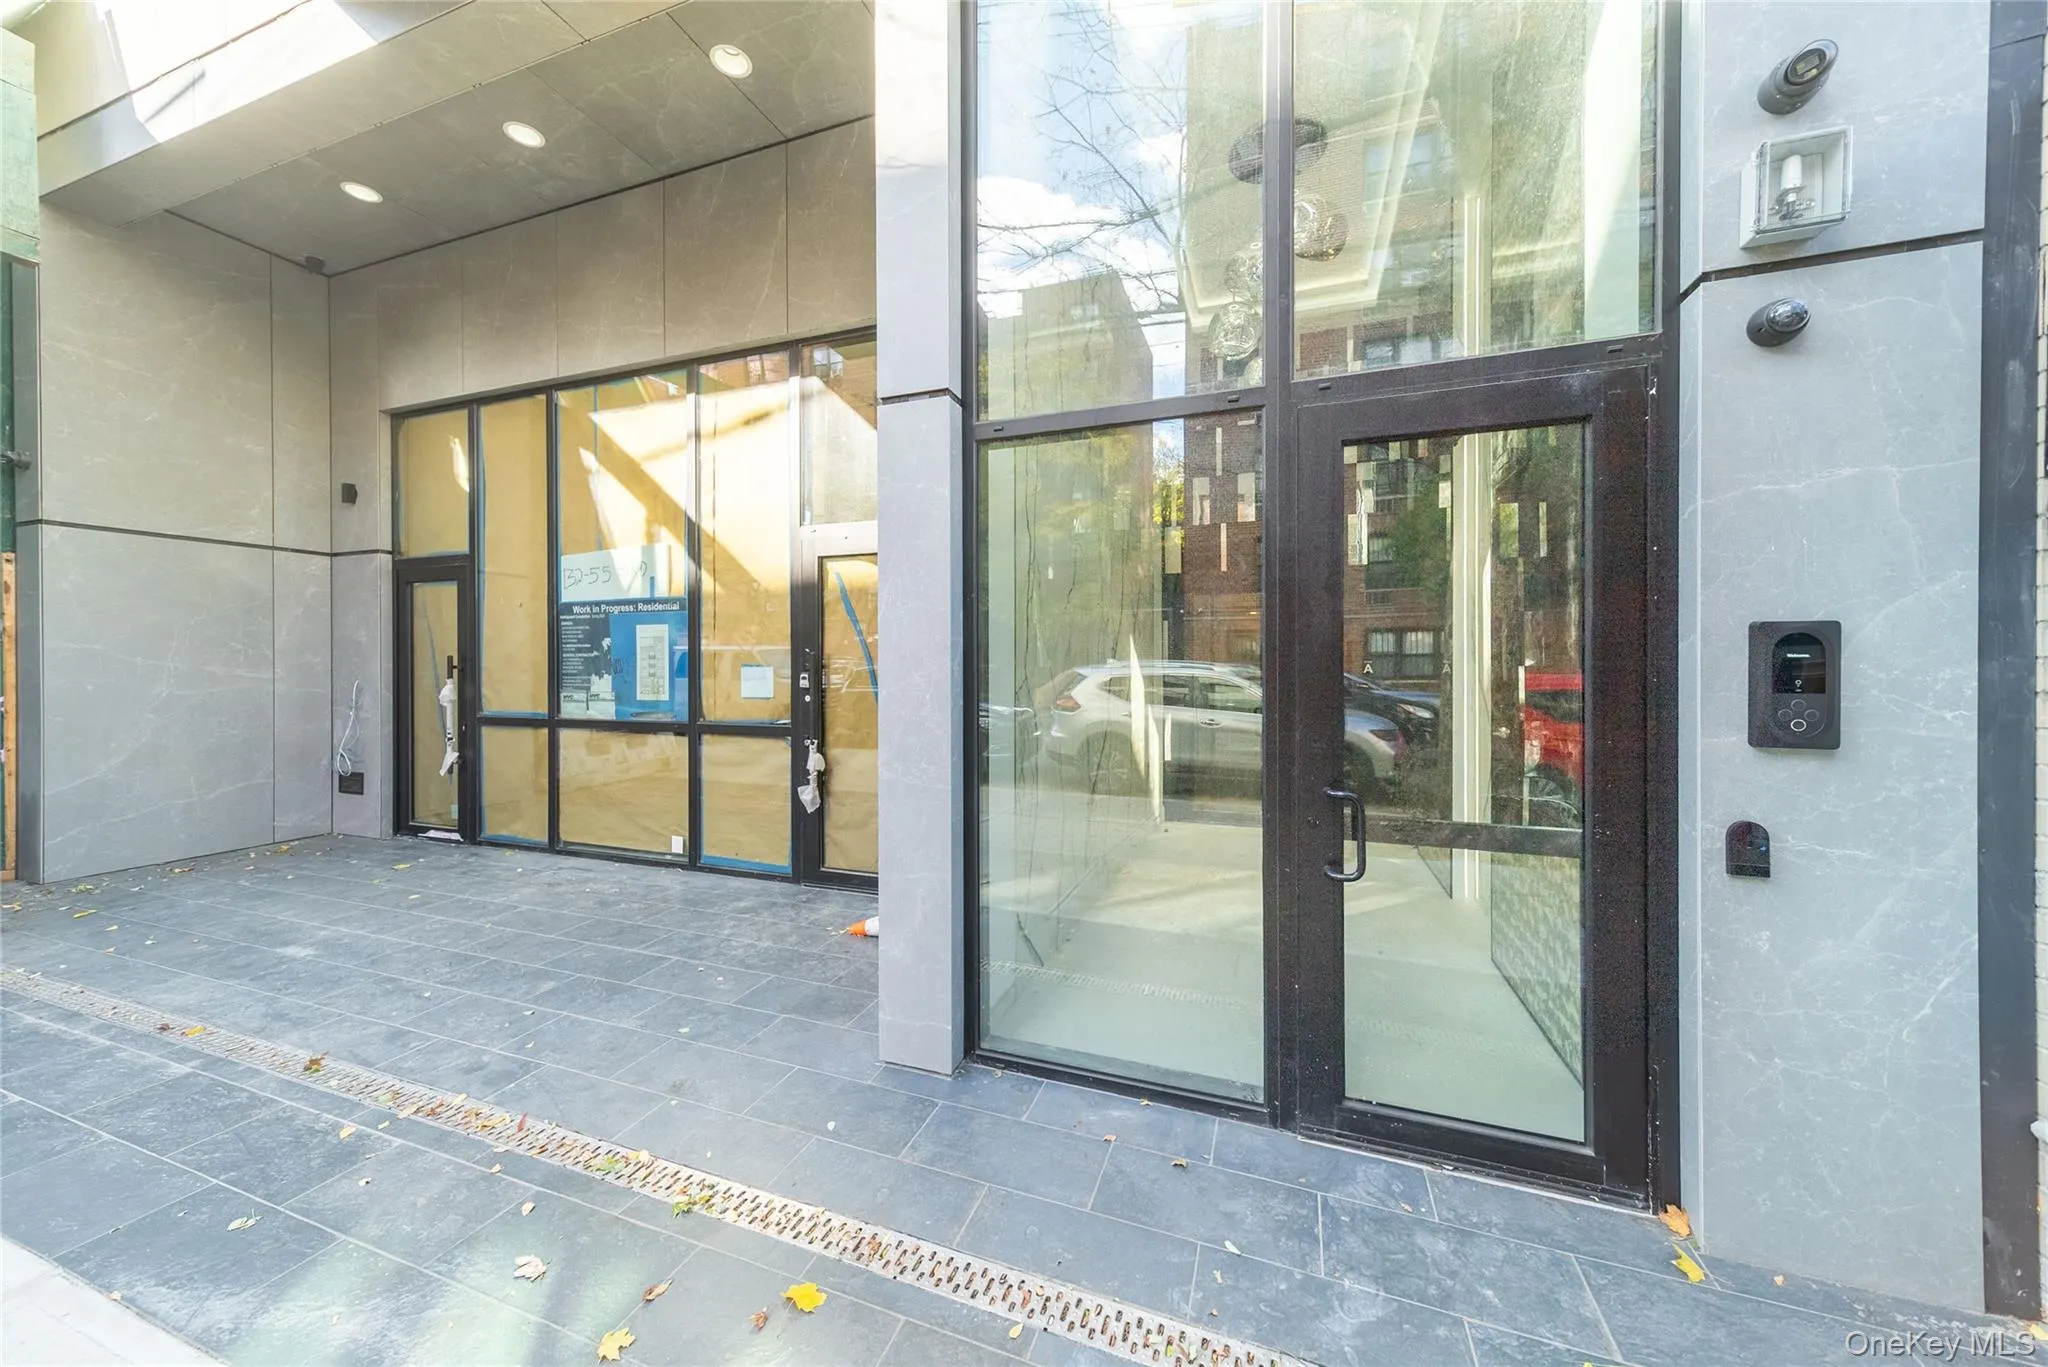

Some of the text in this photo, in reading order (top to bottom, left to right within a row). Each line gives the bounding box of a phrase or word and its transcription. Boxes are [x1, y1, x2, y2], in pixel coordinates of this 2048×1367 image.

[572, 601, 680, 615] Work in Progress: Residential
